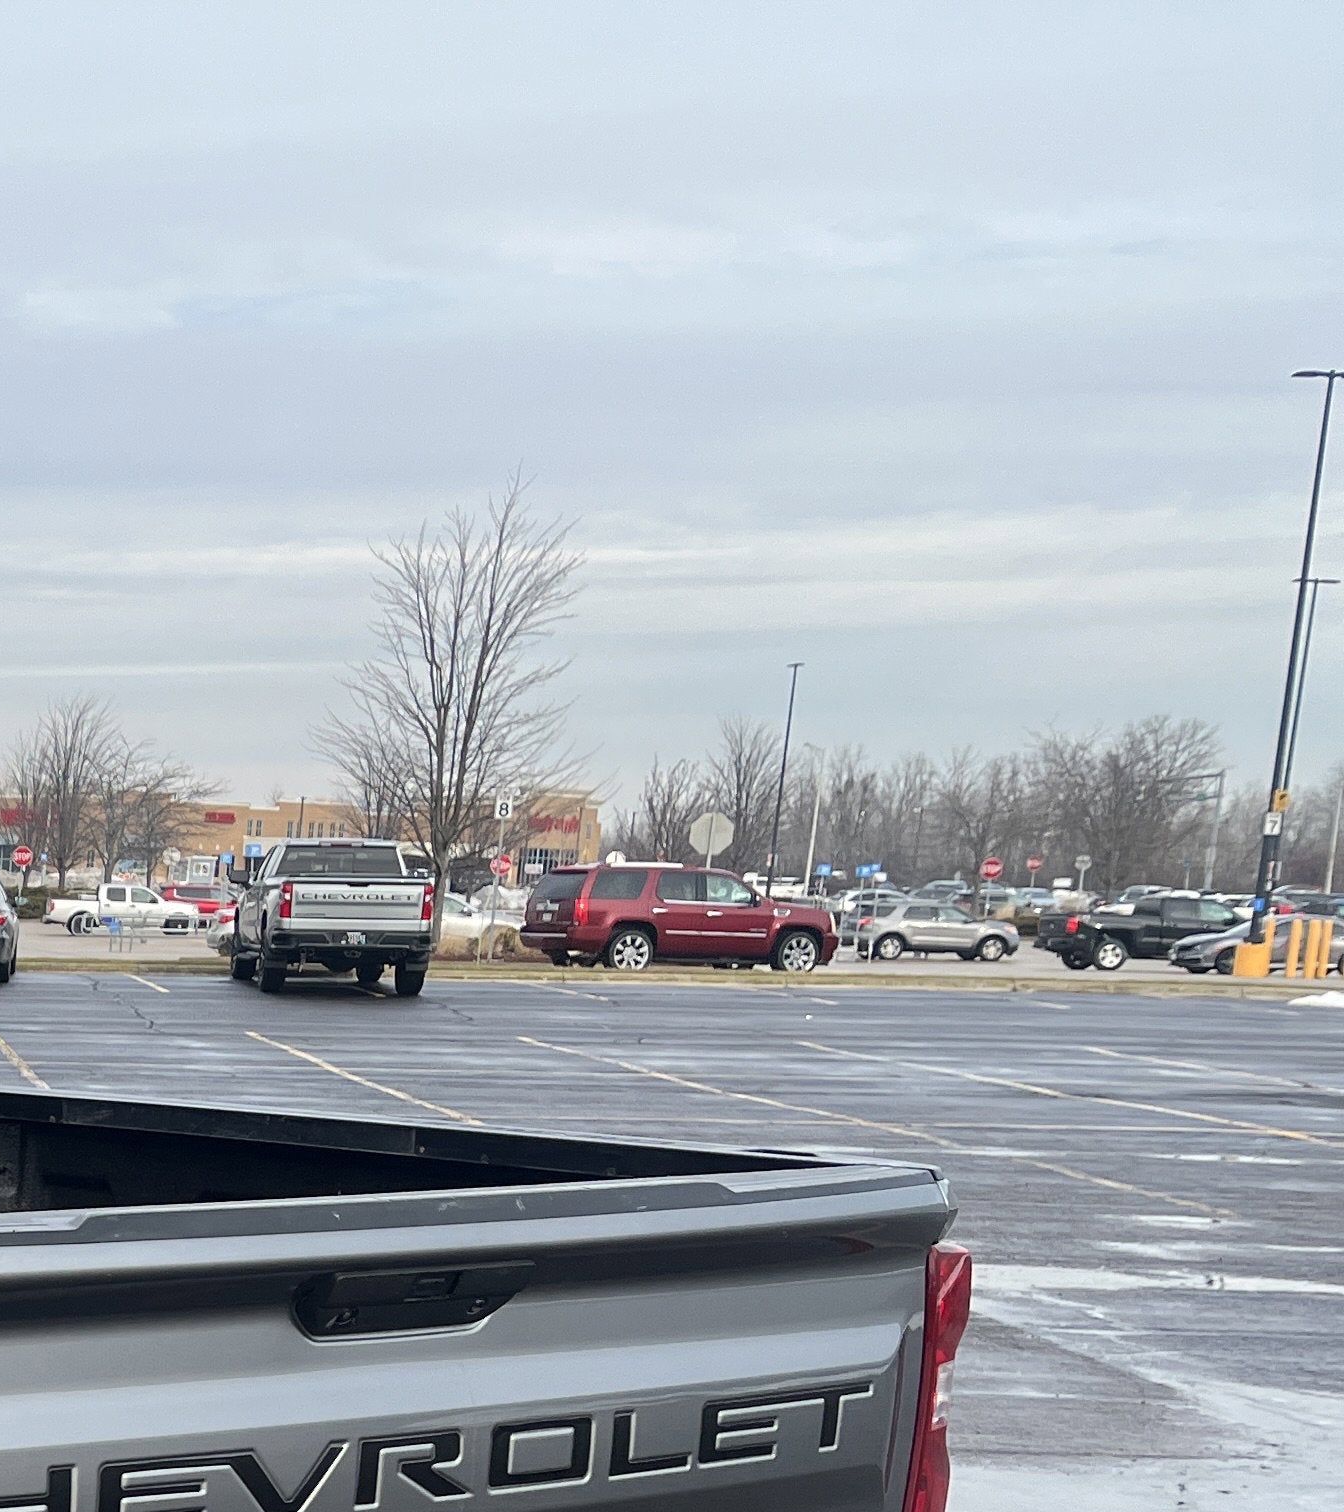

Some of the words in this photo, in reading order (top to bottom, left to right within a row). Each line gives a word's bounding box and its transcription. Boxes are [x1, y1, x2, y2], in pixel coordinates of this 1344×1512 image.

[499, 802, 509, 817] 8
[1269, 819, 1278, 833] 7
[14, 852, 32, 861] STOP
[301, 893, 414, 901] CHEVROLET
